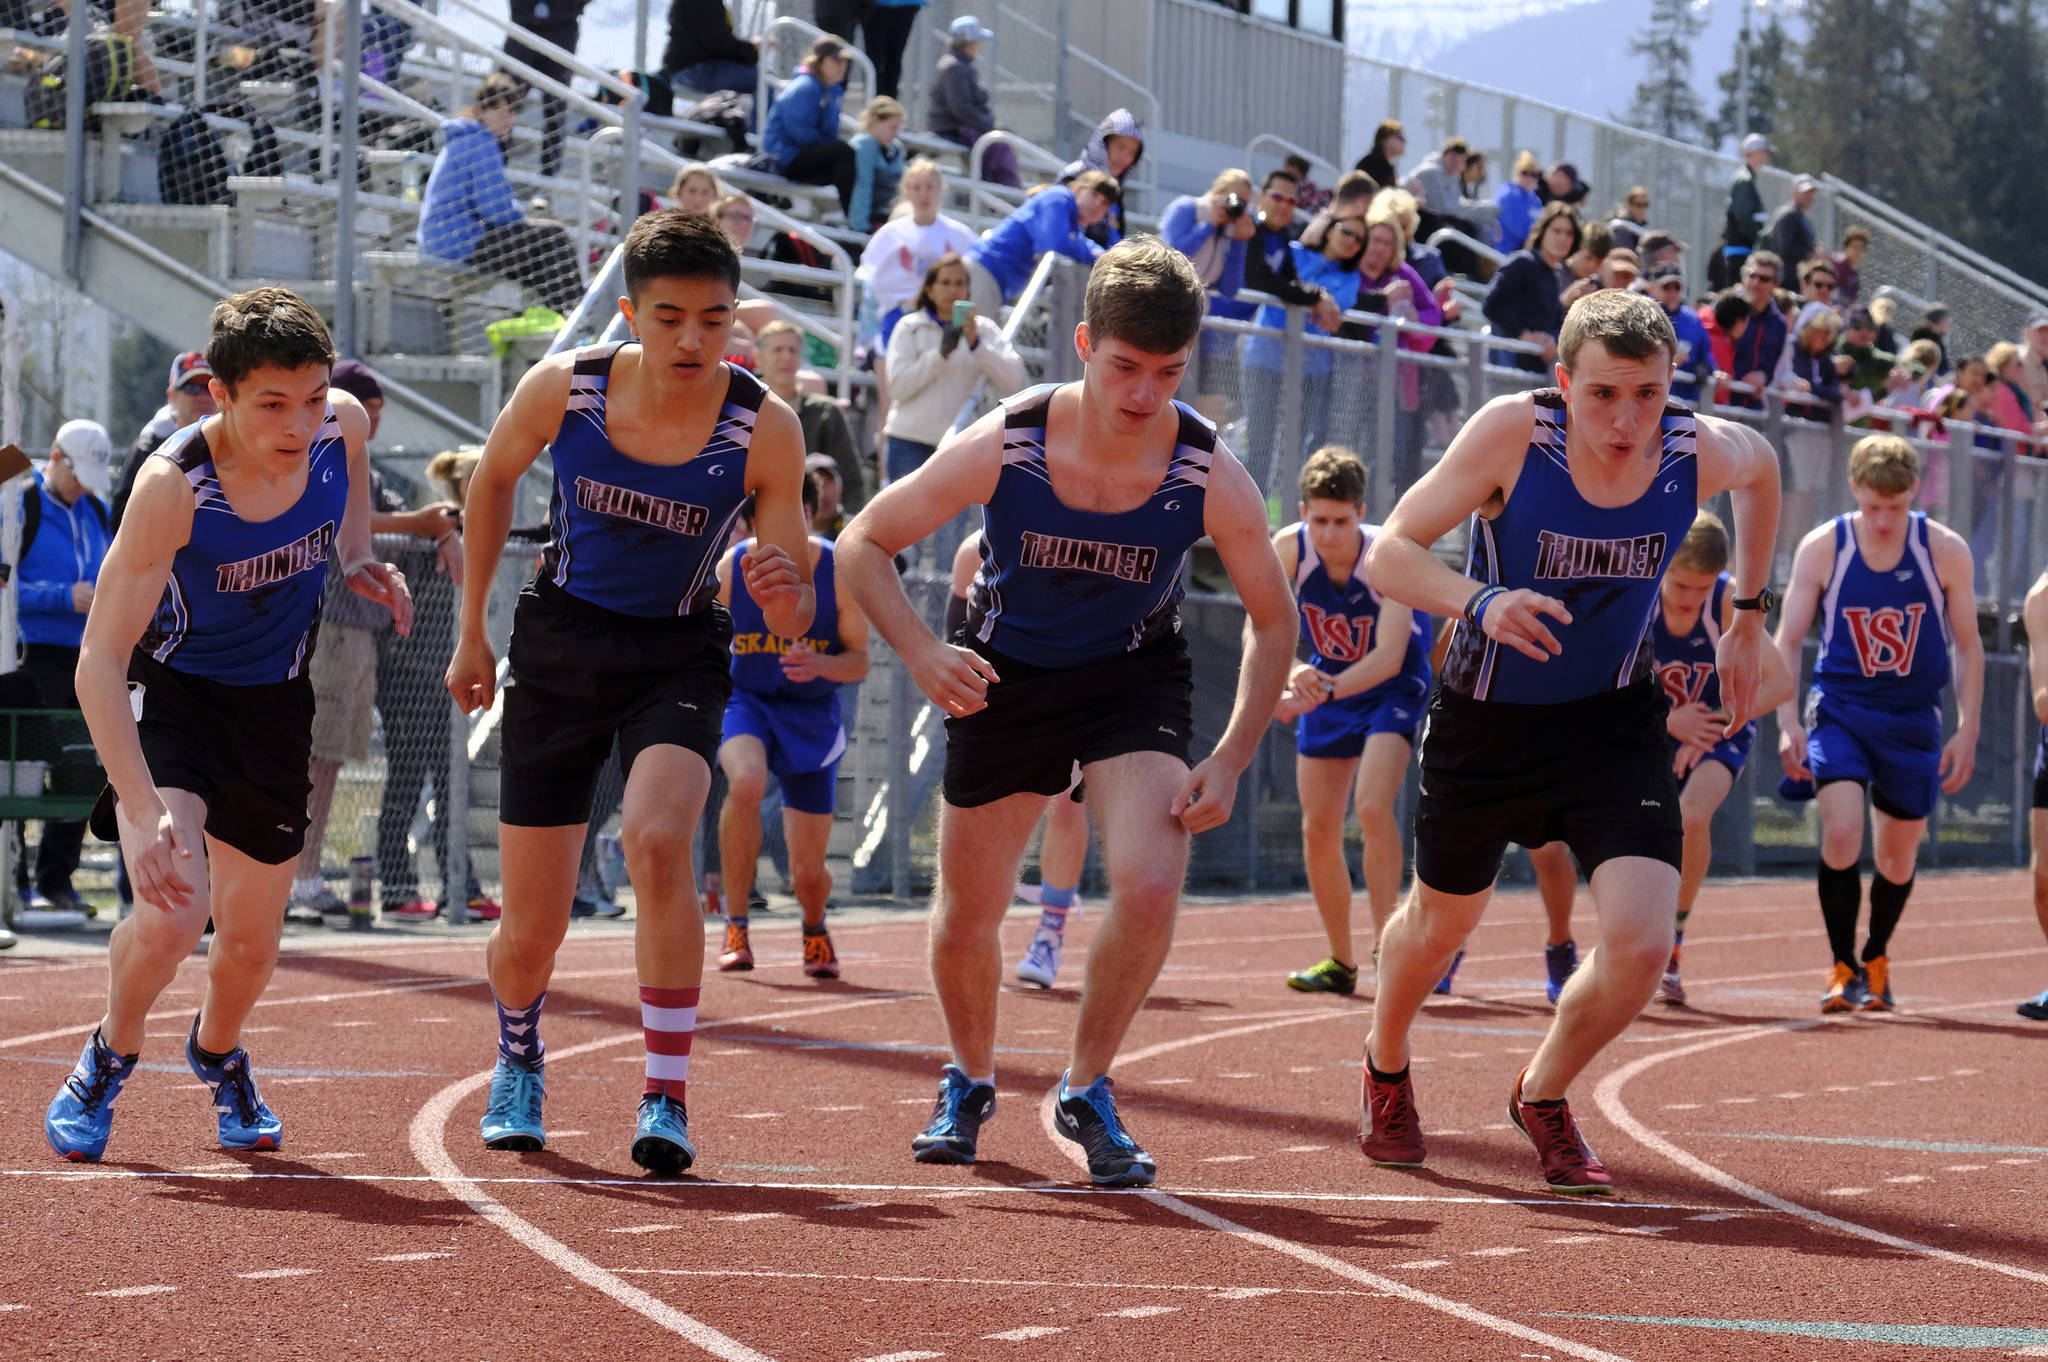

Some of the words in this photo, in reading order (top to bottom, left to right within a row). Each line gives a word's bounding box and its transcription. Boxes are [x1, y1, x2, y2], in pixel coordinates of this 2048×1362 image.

[573, 475, 709, 537] THUNDER
[216, 519, 335, 593] THUNDER
[1020, 530, 1158, 584] THUNDER
[1534, 530, 1667, 580] THUNDER
[734, 633, 830, 656] SKAGAY
